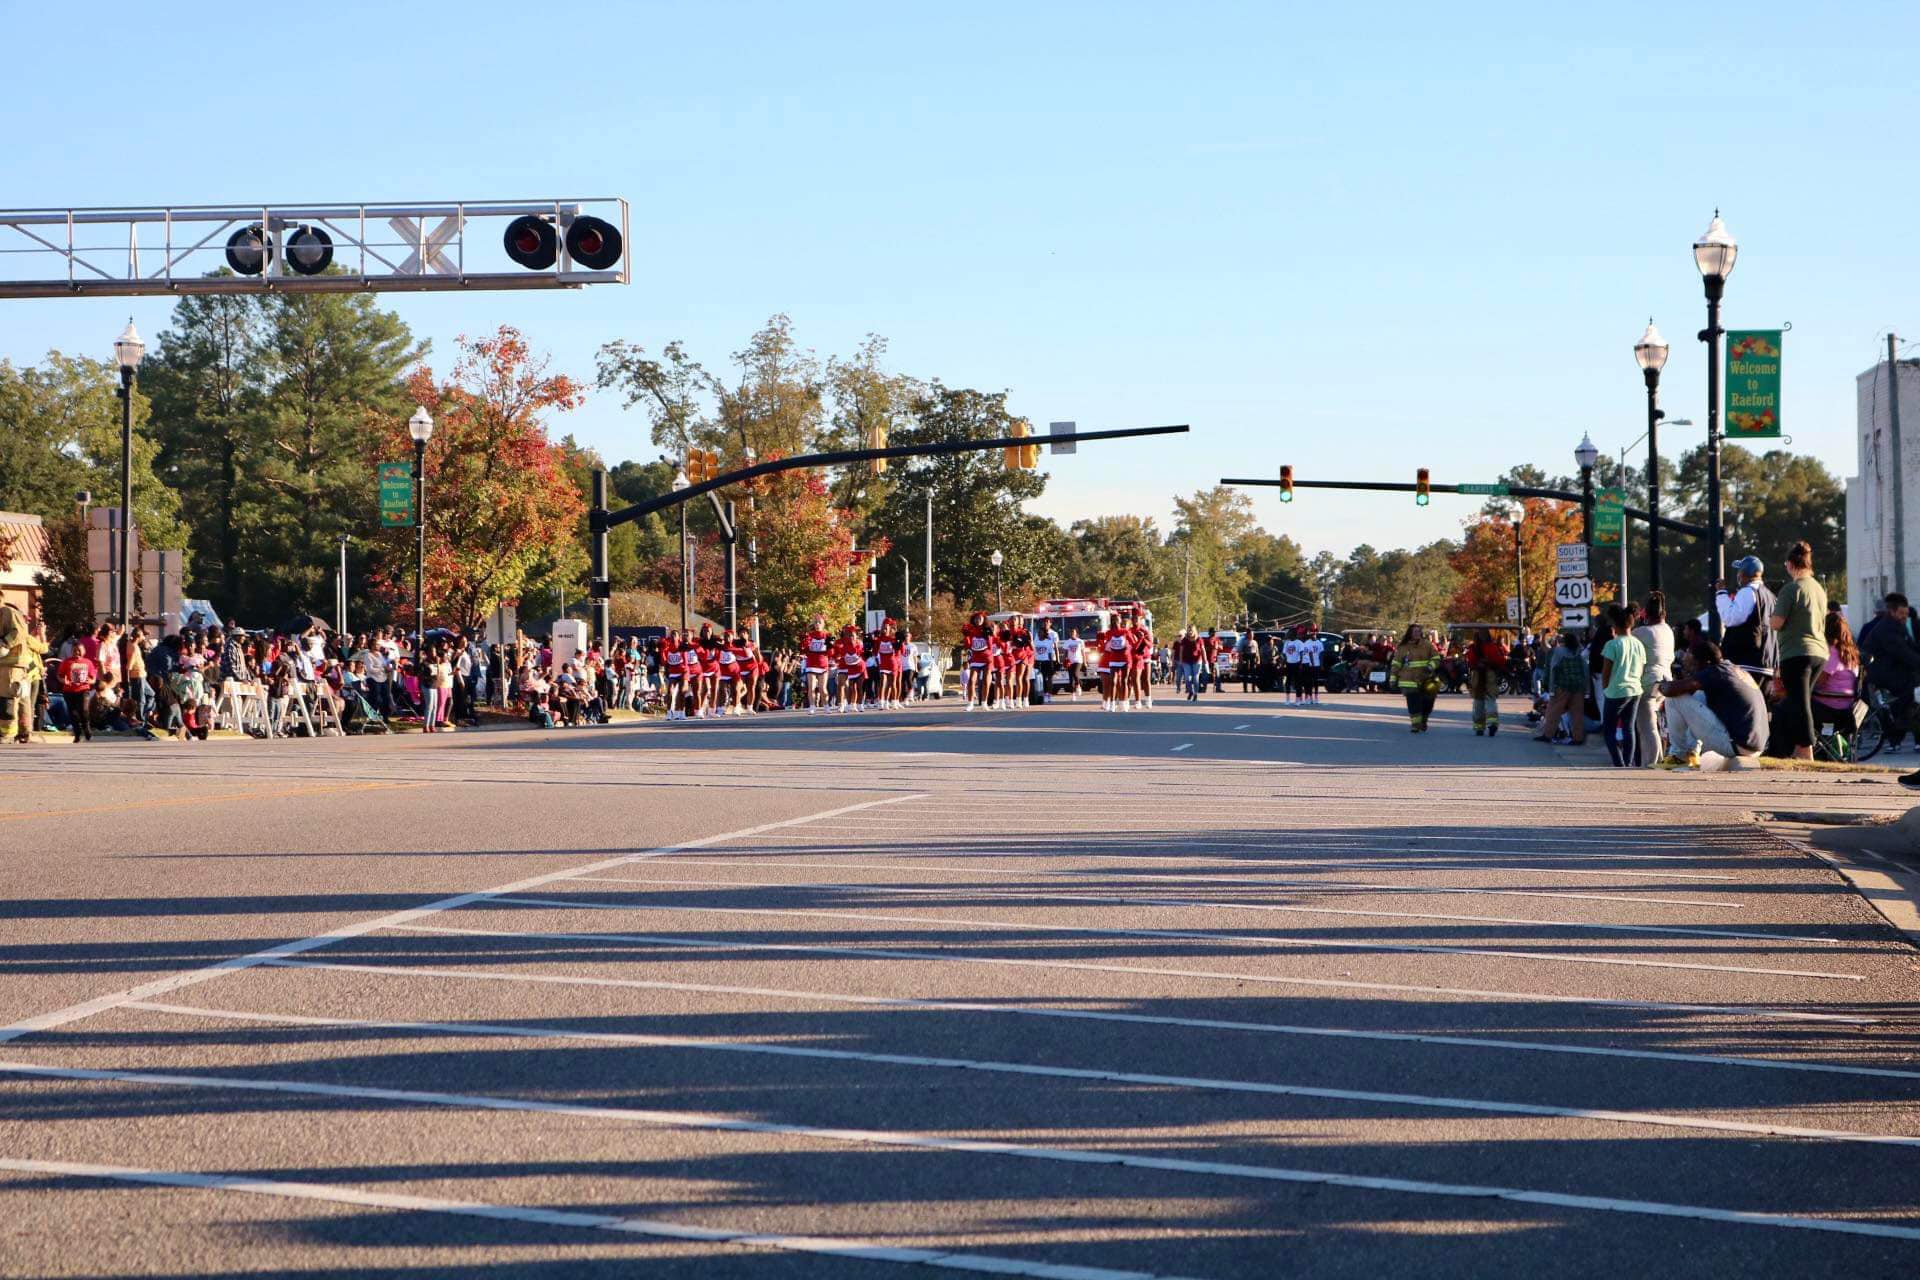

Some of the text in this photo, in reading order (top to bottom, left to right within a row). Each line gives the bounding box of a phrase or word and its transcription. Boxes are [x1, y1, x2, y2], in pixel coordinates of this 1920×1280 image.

[1730, 361, 1777, 375] Welcome
[1747, 378, 1759, 391] to
[1731, 392, 1774, 407] Raeford
[1558, 545, 1585, 556] SOUTH
[1560, 563, 1586, 573] BUSINESS
[1558, 582, 1588, 599] 401
